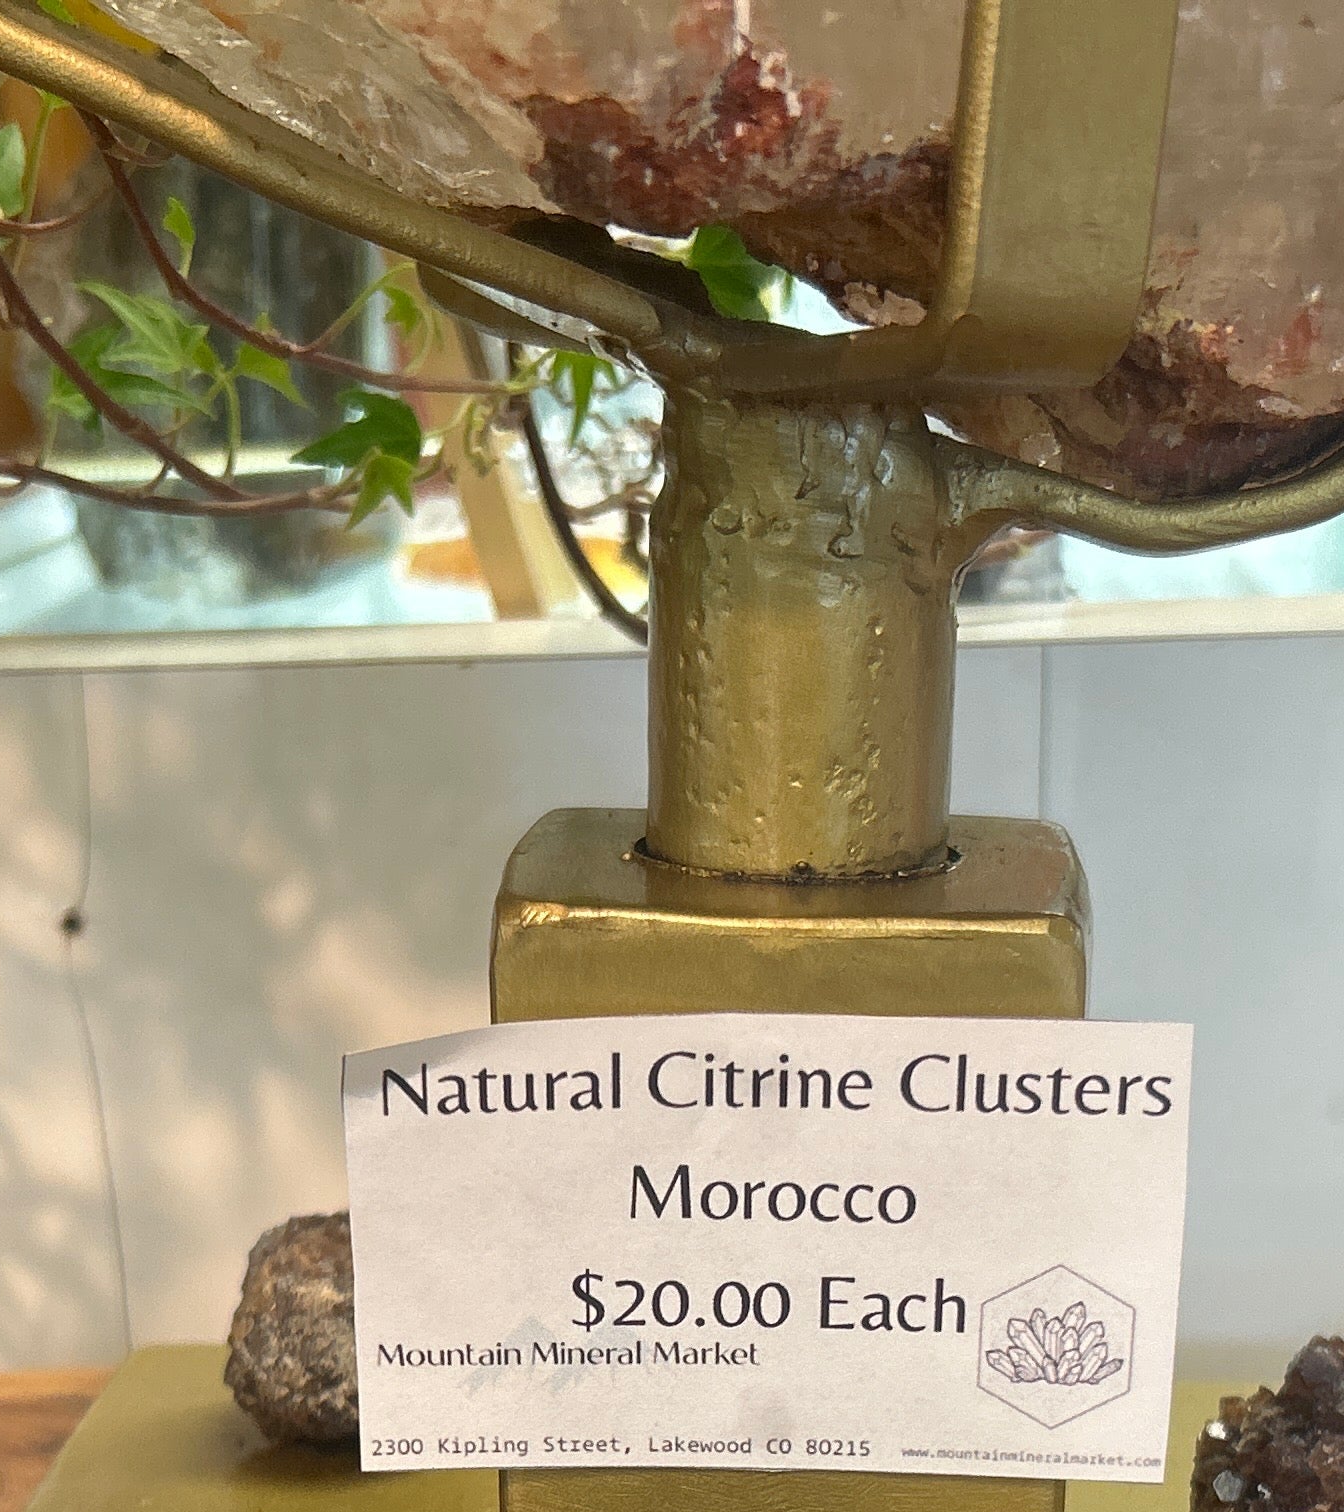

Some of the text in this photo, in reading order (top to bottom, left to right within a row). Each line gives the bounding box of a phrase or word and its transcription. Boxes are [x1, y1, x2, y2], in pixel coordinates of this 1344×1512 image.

[382, 1051, 1173, 1117] Natural Citrine Clusters
[630, 1164, 917, 1224] Morocco
[571, 1268, 966, 1334] $20.00 Each
[376, 1340, 761, 1367] Mountain Mineral Market
[371, 1435, 871, 1457] 2300 Kipling Street, Lakewood CO 80215
[901, 1446, 1162, 1468] www.mountainmineralmarket.com
